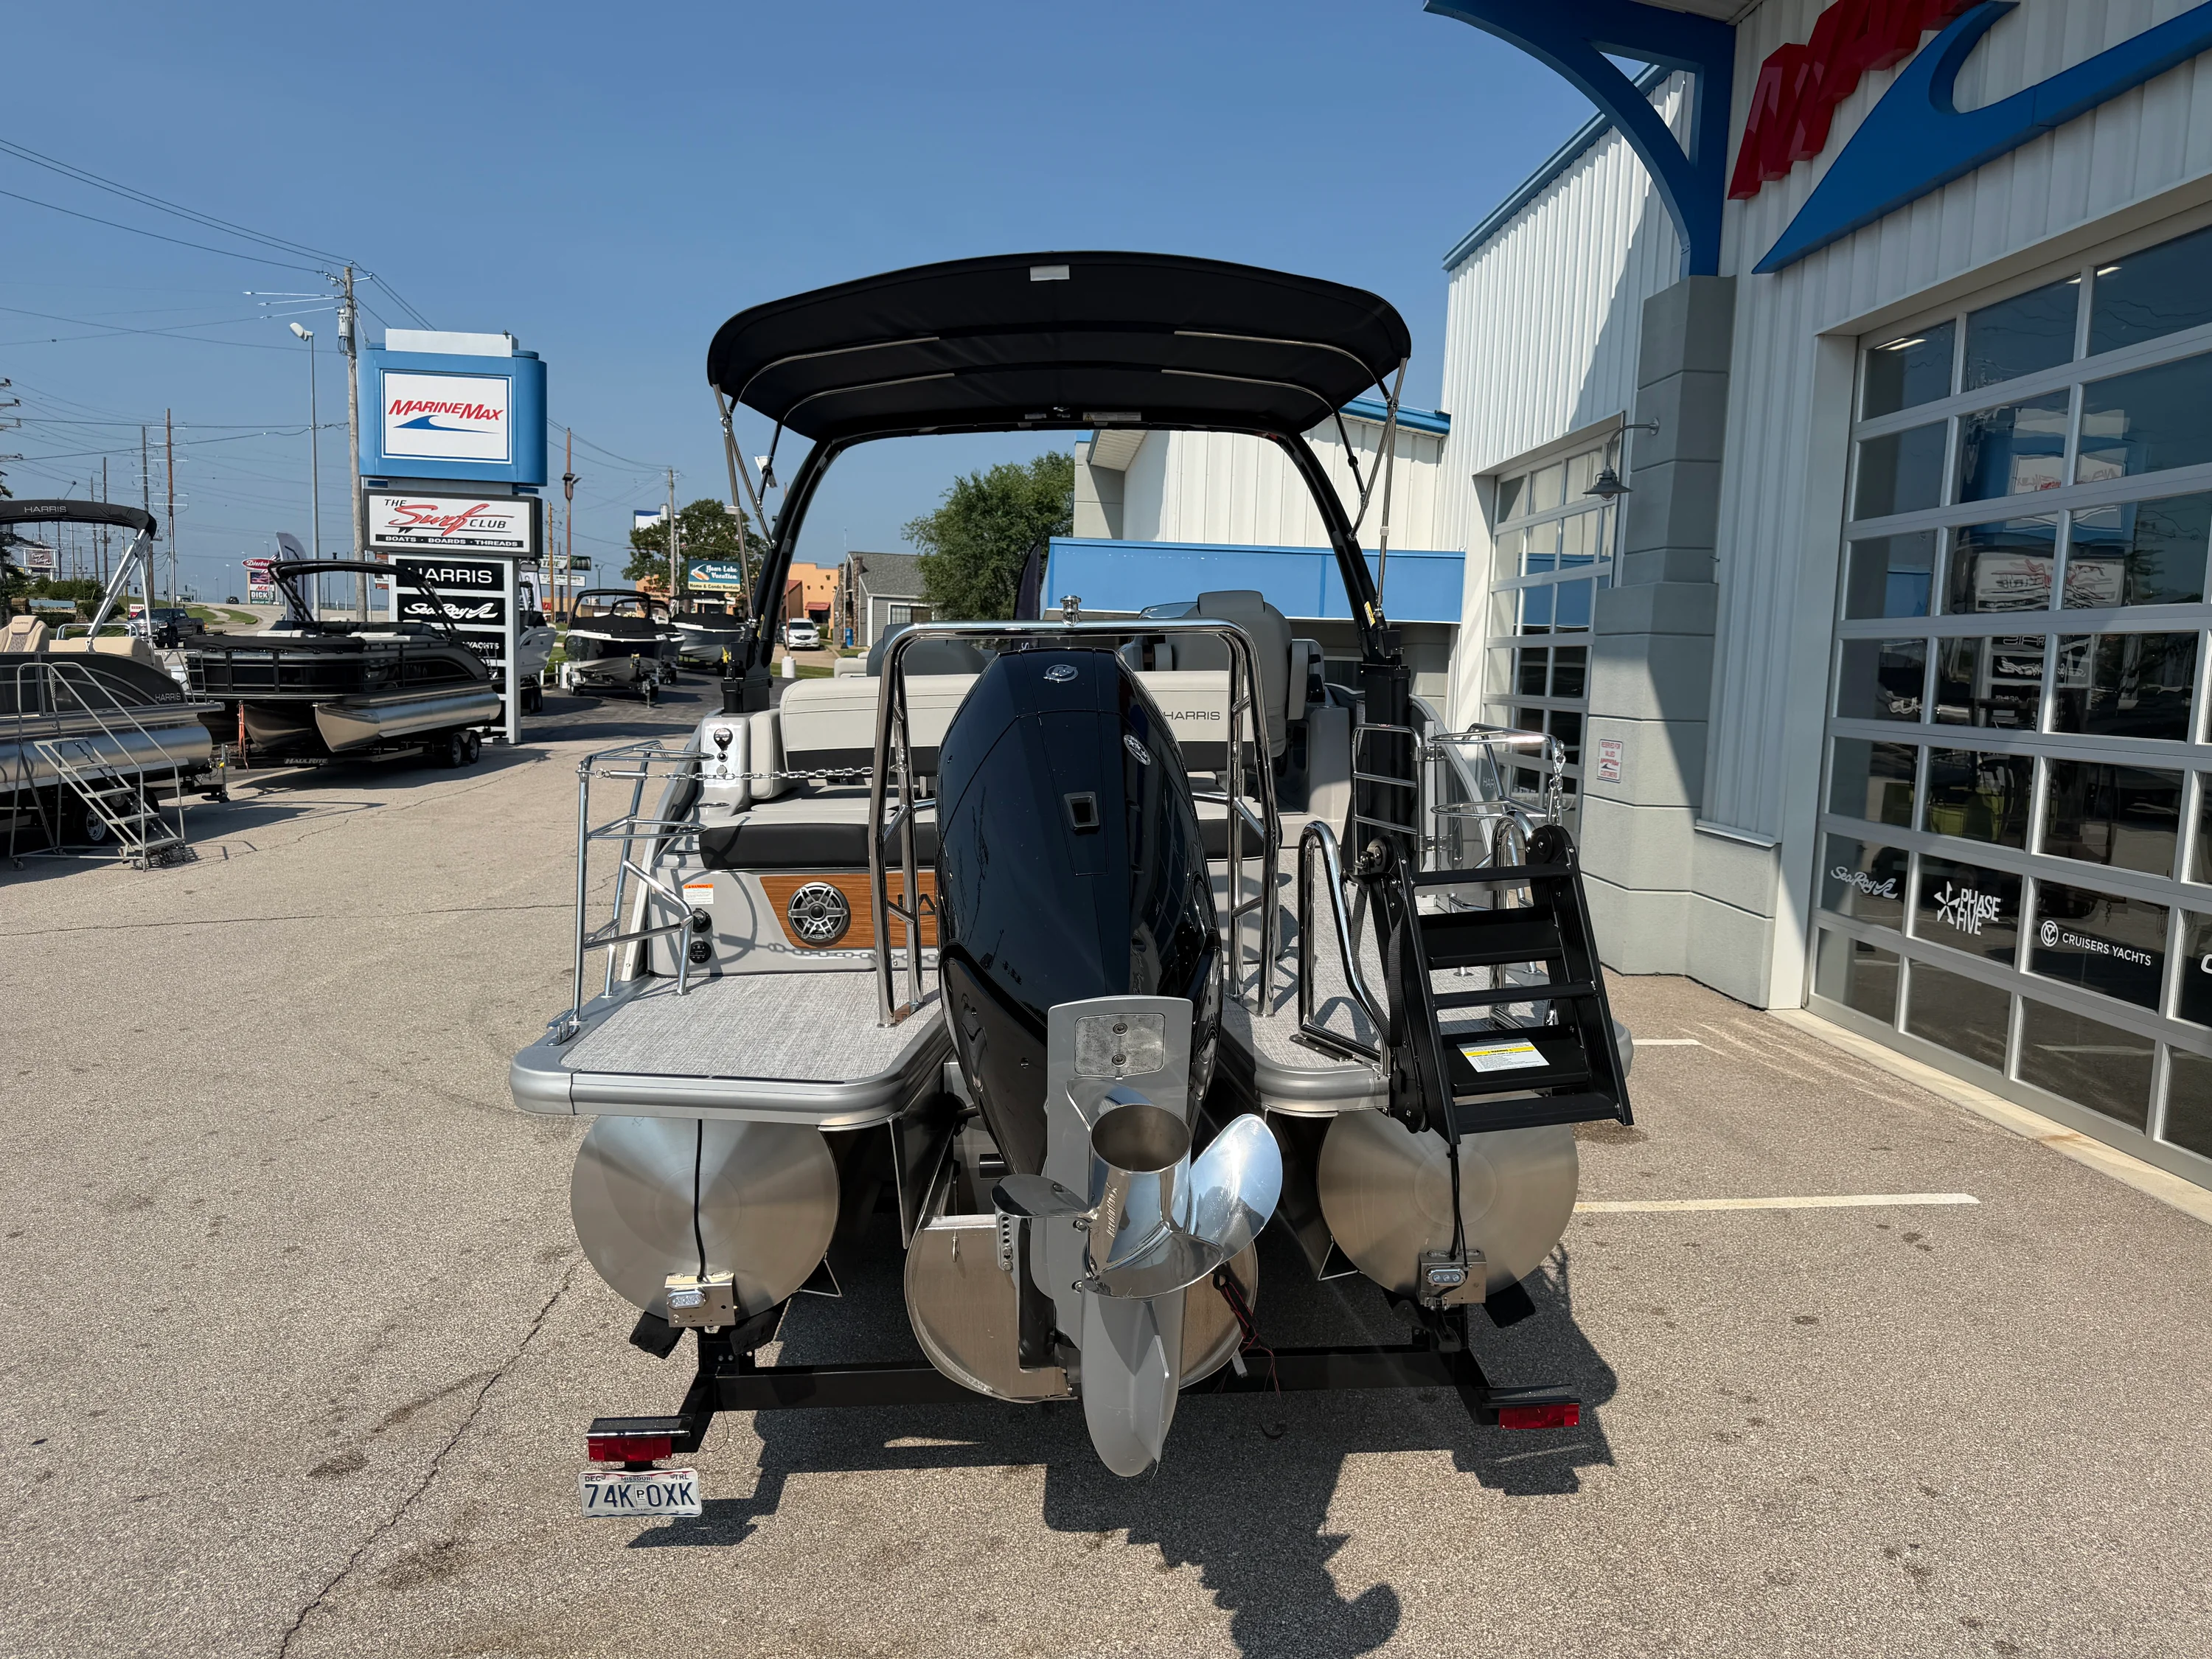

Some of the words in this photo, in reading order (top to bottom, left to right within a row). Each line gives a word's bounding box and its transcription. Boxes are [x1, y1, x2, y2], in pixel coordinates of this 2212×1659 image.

[384, 498, 407, 507] THE
[389, 504, 493, 537] Surf
[469, 518, 507, 529] CLUB
[428, 537, 467, 546] BOARDS
[474, 539, 518, 547] THREADS
[408, 567, 493, 584] ARRIS
[467, 641, 500, 650] YACHTS
[155, 692, 181, 701] HARRIS
[1164, 711, 1220, 720] HARRIS
[1959, 887, 2002, 922] PHASE
[1956, 904, 1983, 936] FIVE
[2062, 932, 2110, 955] CRUISERS
[2112, 945, 2152, 967] YACHTS
[585, 1484, 636, 1509] 74K
